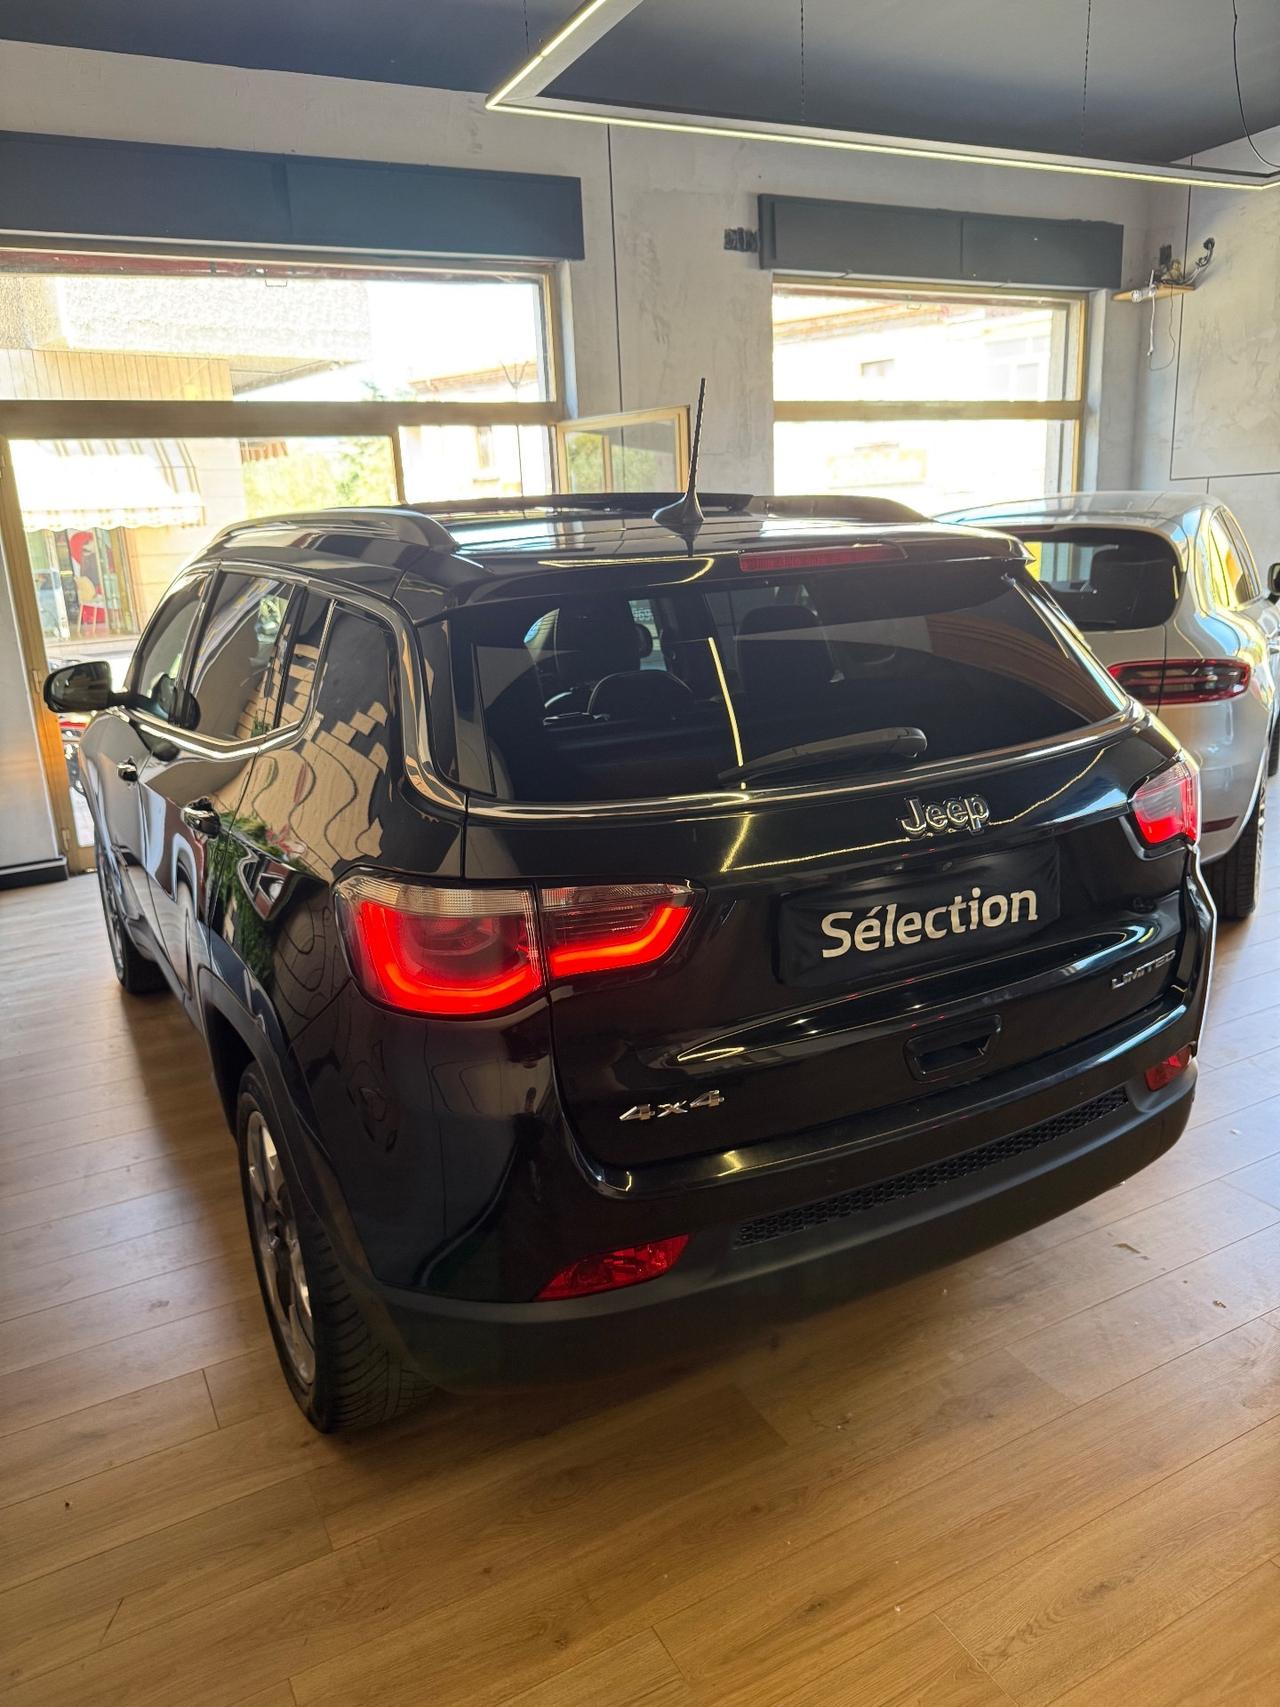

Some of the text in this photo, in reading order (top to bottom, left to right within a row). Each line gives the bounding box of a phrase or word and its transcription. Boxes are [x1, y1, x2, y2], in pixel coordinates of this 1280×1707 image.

[899, 796, 990, 835] Jeep
[821, 887, 1038, 958] Sélection
[1111, 949, 1176, 990] LIMITED
